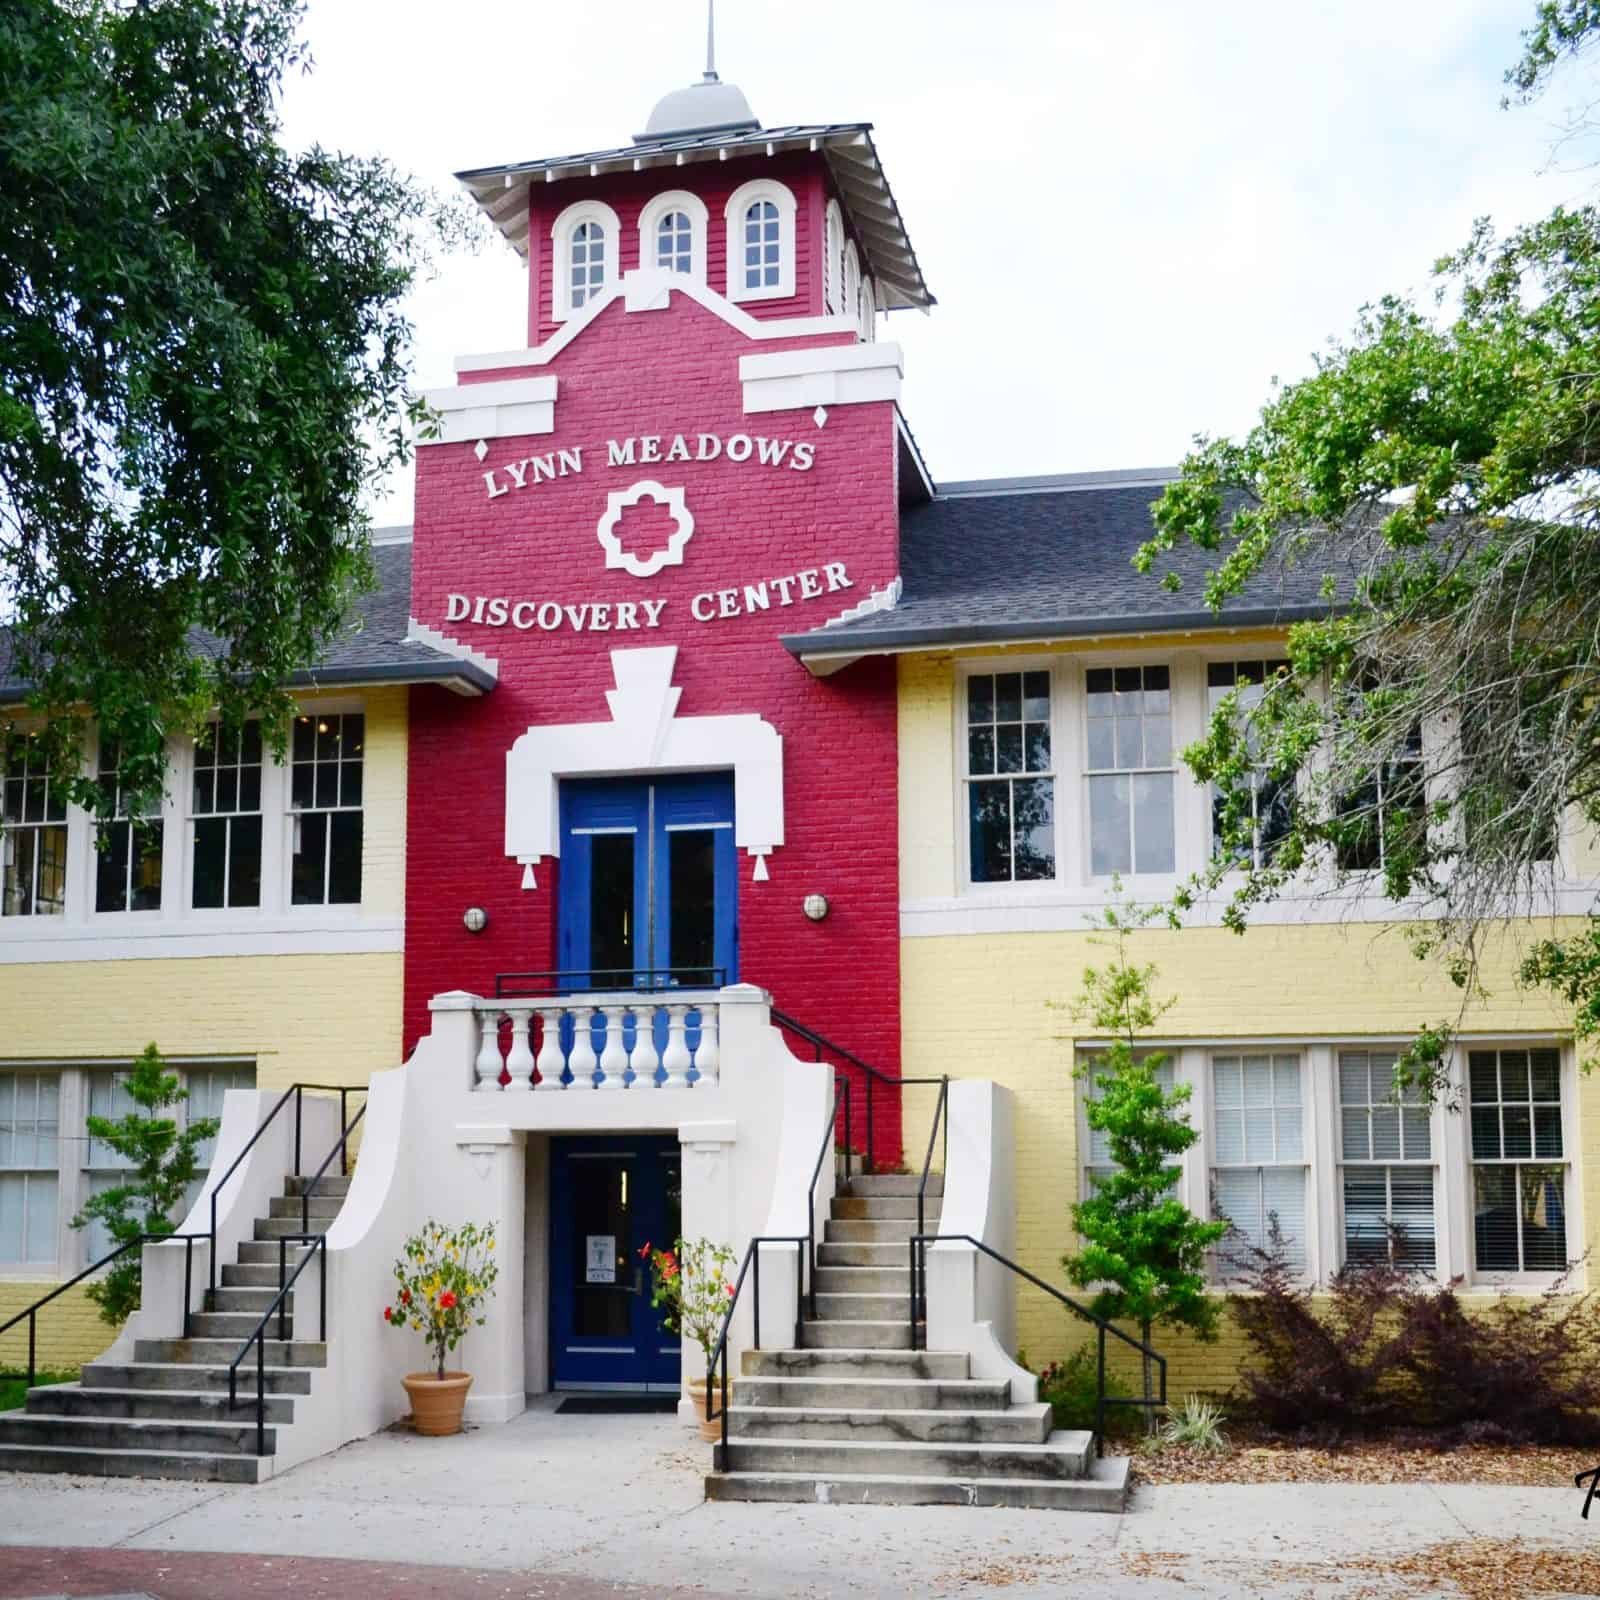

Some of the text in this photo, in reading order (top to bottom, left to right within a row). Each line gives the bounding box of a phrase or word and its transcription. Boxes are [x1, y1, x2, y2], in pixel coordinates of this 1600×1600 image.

[482, 433, 817, 498] LYNN MEADOWS
[446, 561, 854, 632] DISCOVERY CENTER
